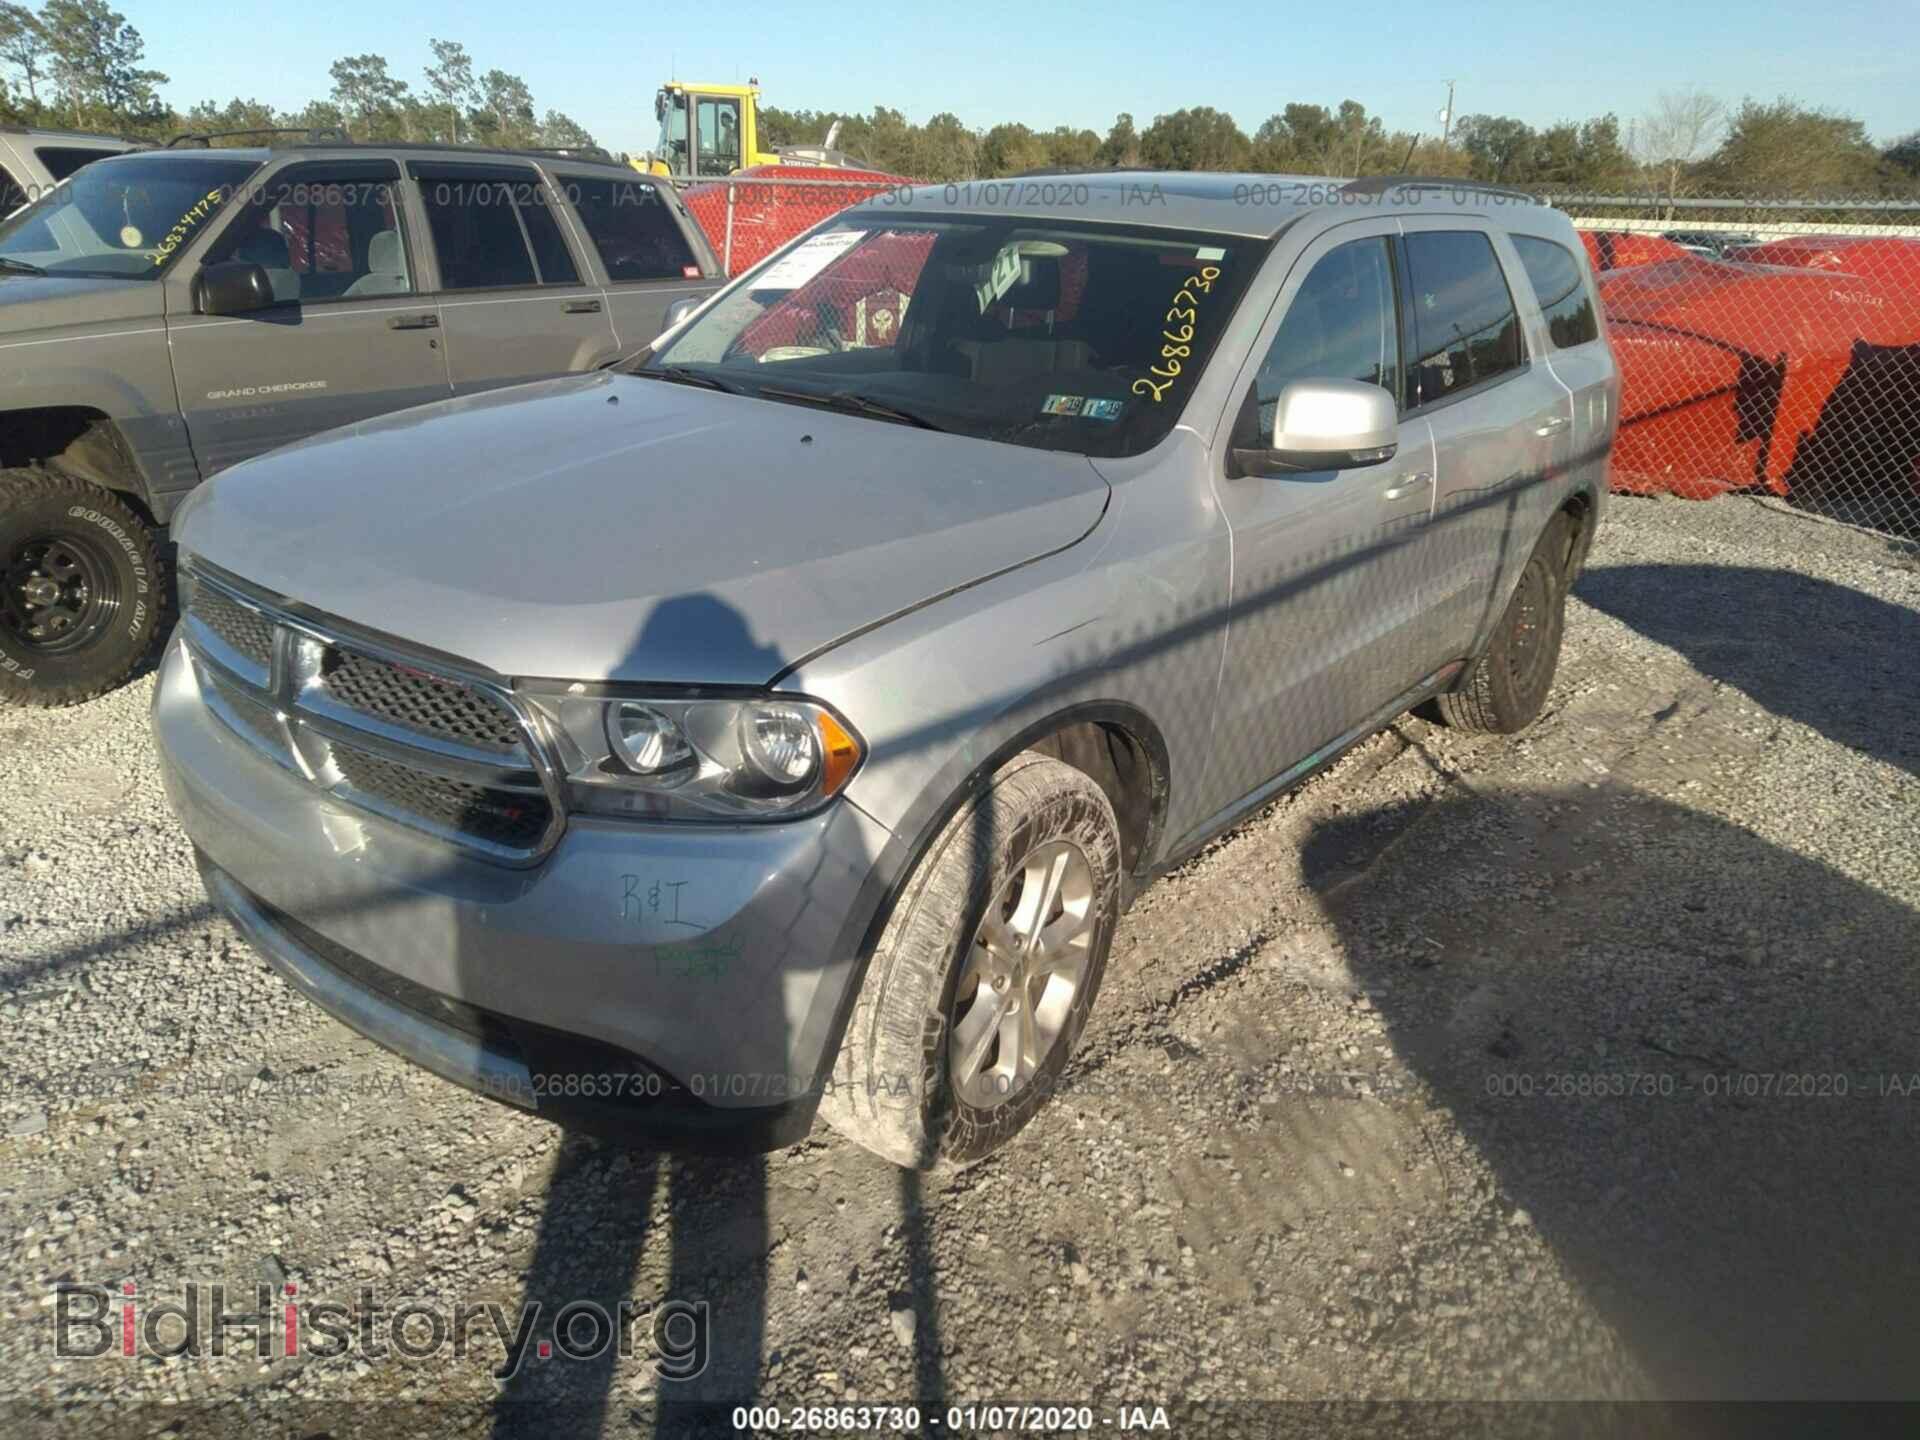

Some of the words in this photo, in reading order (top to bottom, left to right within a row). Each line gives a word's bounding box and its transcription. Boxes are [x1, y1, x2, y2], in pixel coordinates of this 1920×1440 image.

[1132, 266, 1220, 401] 26863730
[206, 387, 256, 400] GRAND
[258, 379, 328, 395] CHEROKEE
